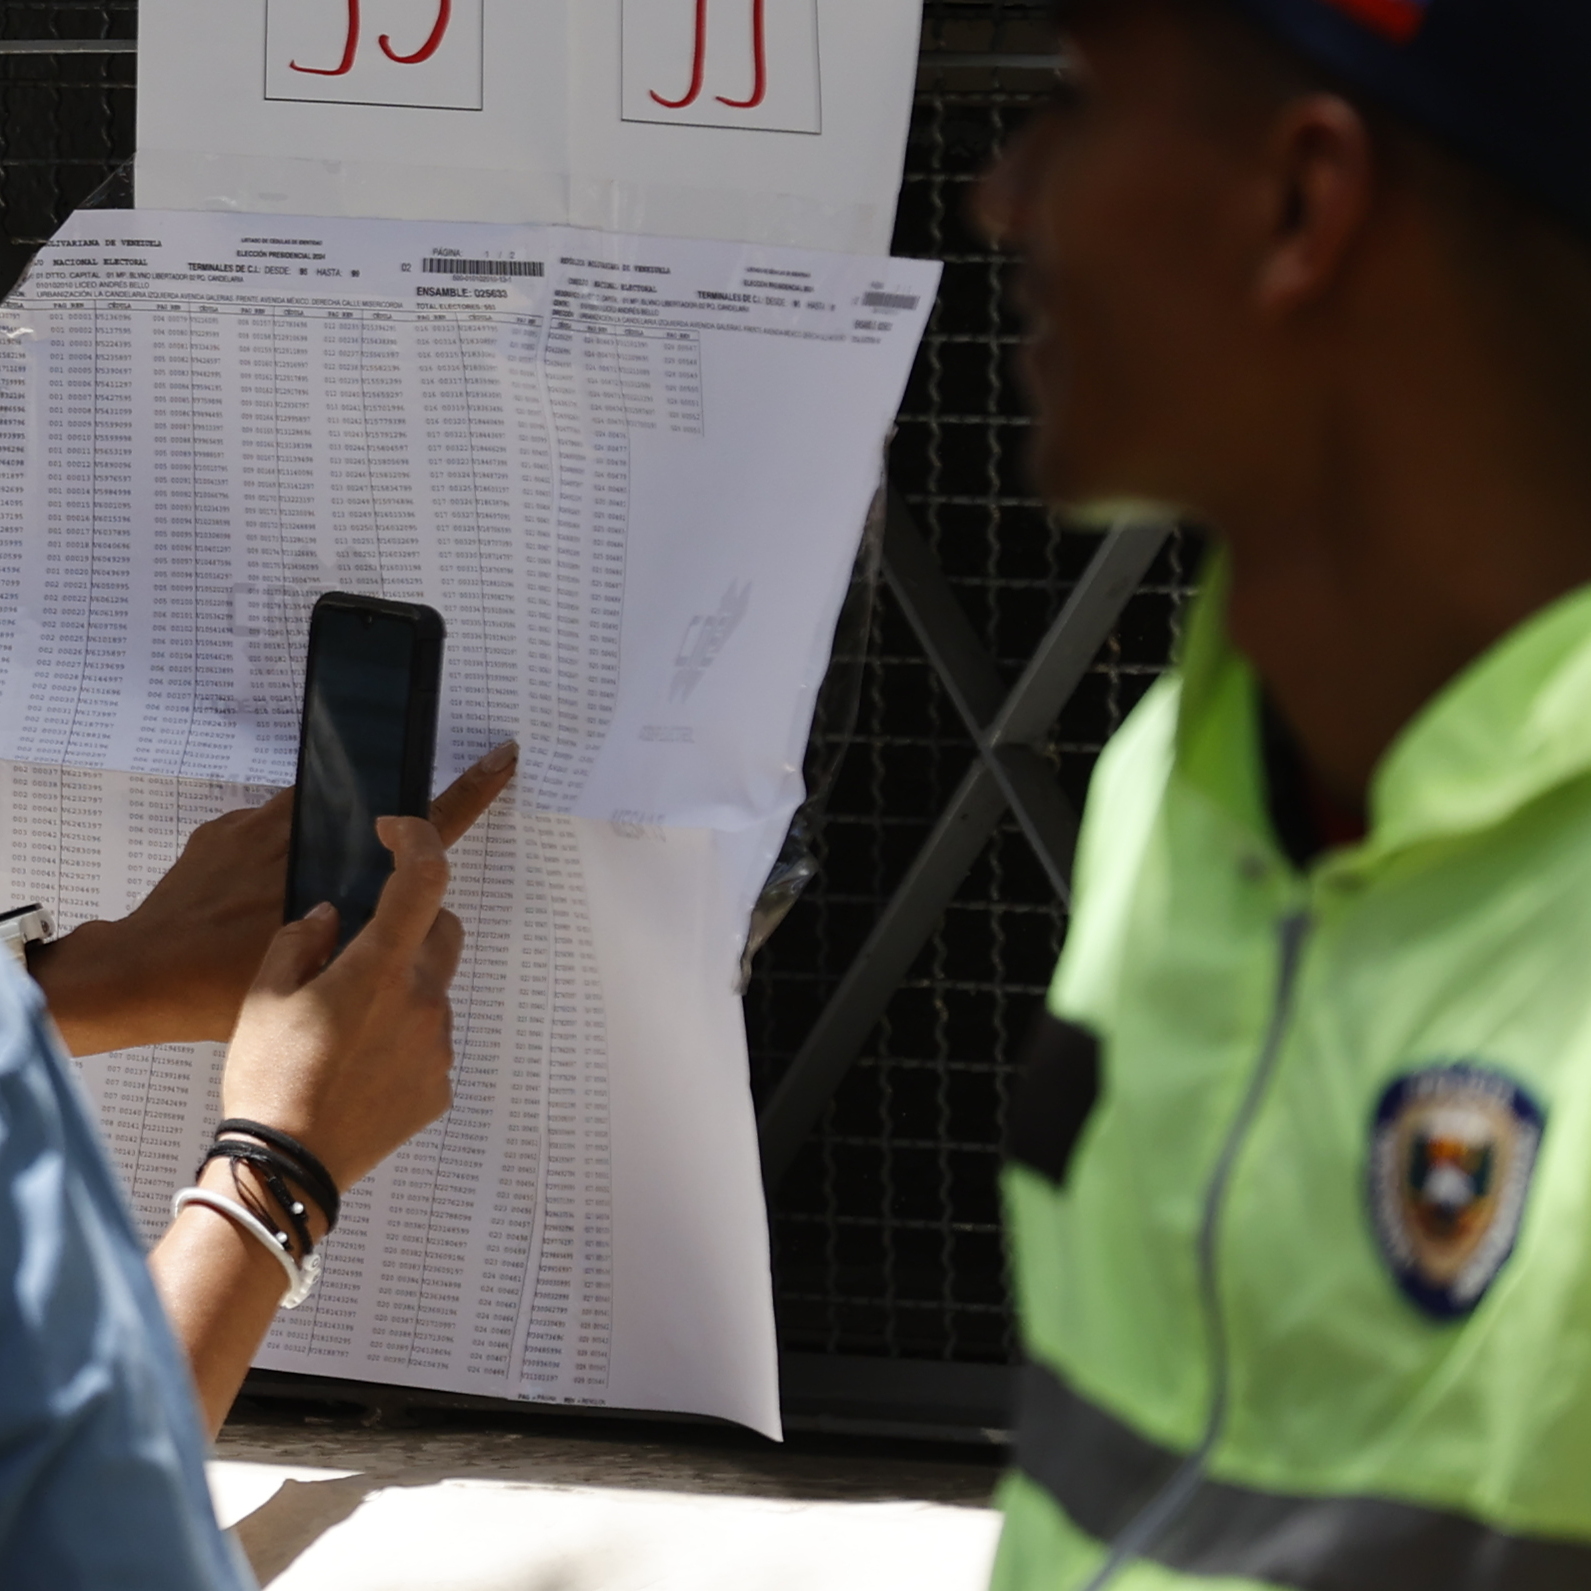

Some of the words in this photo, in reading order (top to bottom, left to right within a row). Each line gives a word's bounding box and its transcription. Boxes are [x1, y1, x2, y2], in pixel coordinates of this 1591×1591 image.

[104, 239, 116, 247] DE
[236, 249, 268, 258] ELECCIÓN
[268, 251, 311, 260] PRESIDENCIAL
[53, 258, 98, 267] NACIONAL
[103, 258, 148, 267] ELECTORAL
[401, 262, 412, 272] 02
[187, 262, 234, 273] TERMINALES
[235, 265, 246, 274] DE
[264, 266, 292, 276] DESDE:
[299, 268, 308, 276] 95
[74, 281, 97, 289] LICEO
[99, 280, 128, 289] ANDRÉS
[129, 282, 150, 290] BELLO
[37, 289, 92, 298] URBANIZACIÓN
[93, 290, 103, 298] LA
[104, 290, 146, 299] CANDELARIA
[260, 295, 286, 304] AVENIDA
[416, 286, 472, 298] ENSAMBLE:
[697, 291, 742, 302] TERMINALES
[13, 765, 28, 773] 002
[32, 767, 58, 775] 00037
[13, 778, 27, 786] 002
[32, 780, 58, 788] 00038
[13, 790, 27, 798] 002
[32, 792, 58, 800] 00039
[13, 803, 27, 811] 002
[32, 805, 58, 813] 00040
[386, 1233, 400, 1241] 020
[403, 1234, 424, 1244] 00381
[384, 1246, 397, 1255] 020
[401, 1248, 423, 1258] 00382
